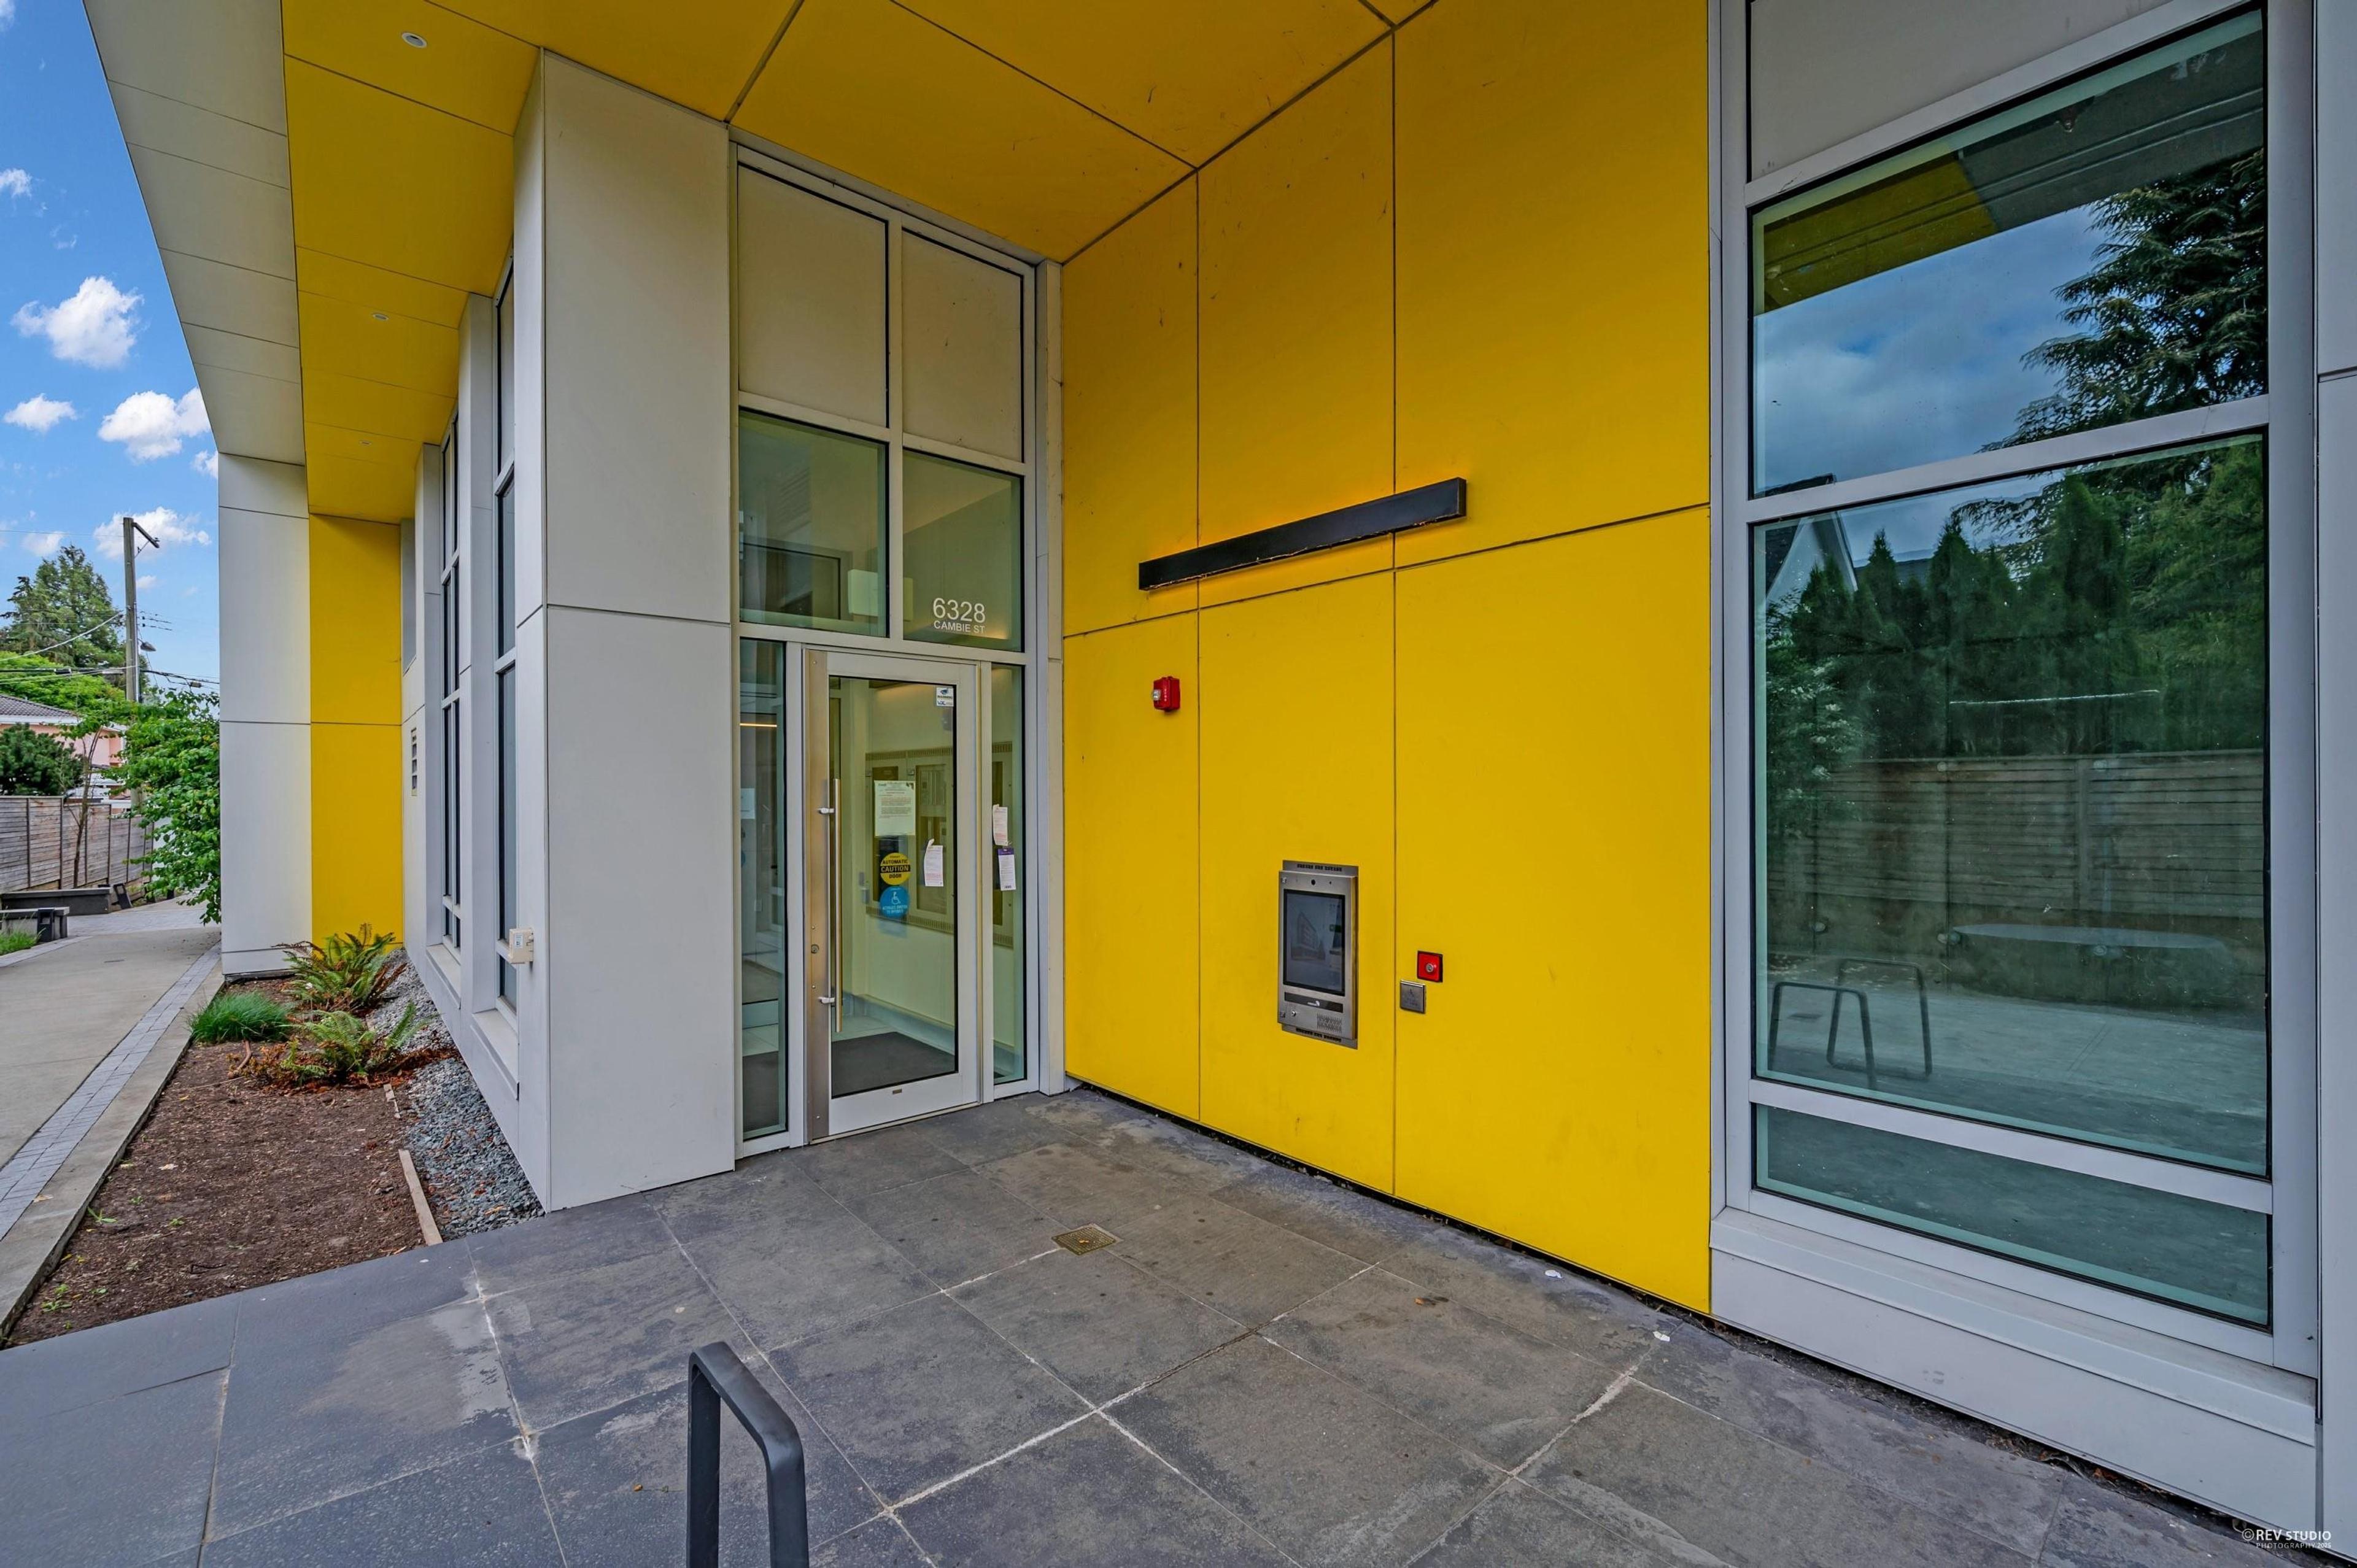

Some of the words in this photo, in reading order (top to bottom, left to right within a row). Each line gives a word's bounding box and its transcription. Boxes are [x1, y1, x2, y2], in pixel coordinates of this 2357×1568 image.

[933, 597, 985, 623] 6328
[934, 620, 971, 632] CAMBIE
[973, 625, 985, 634] ST
